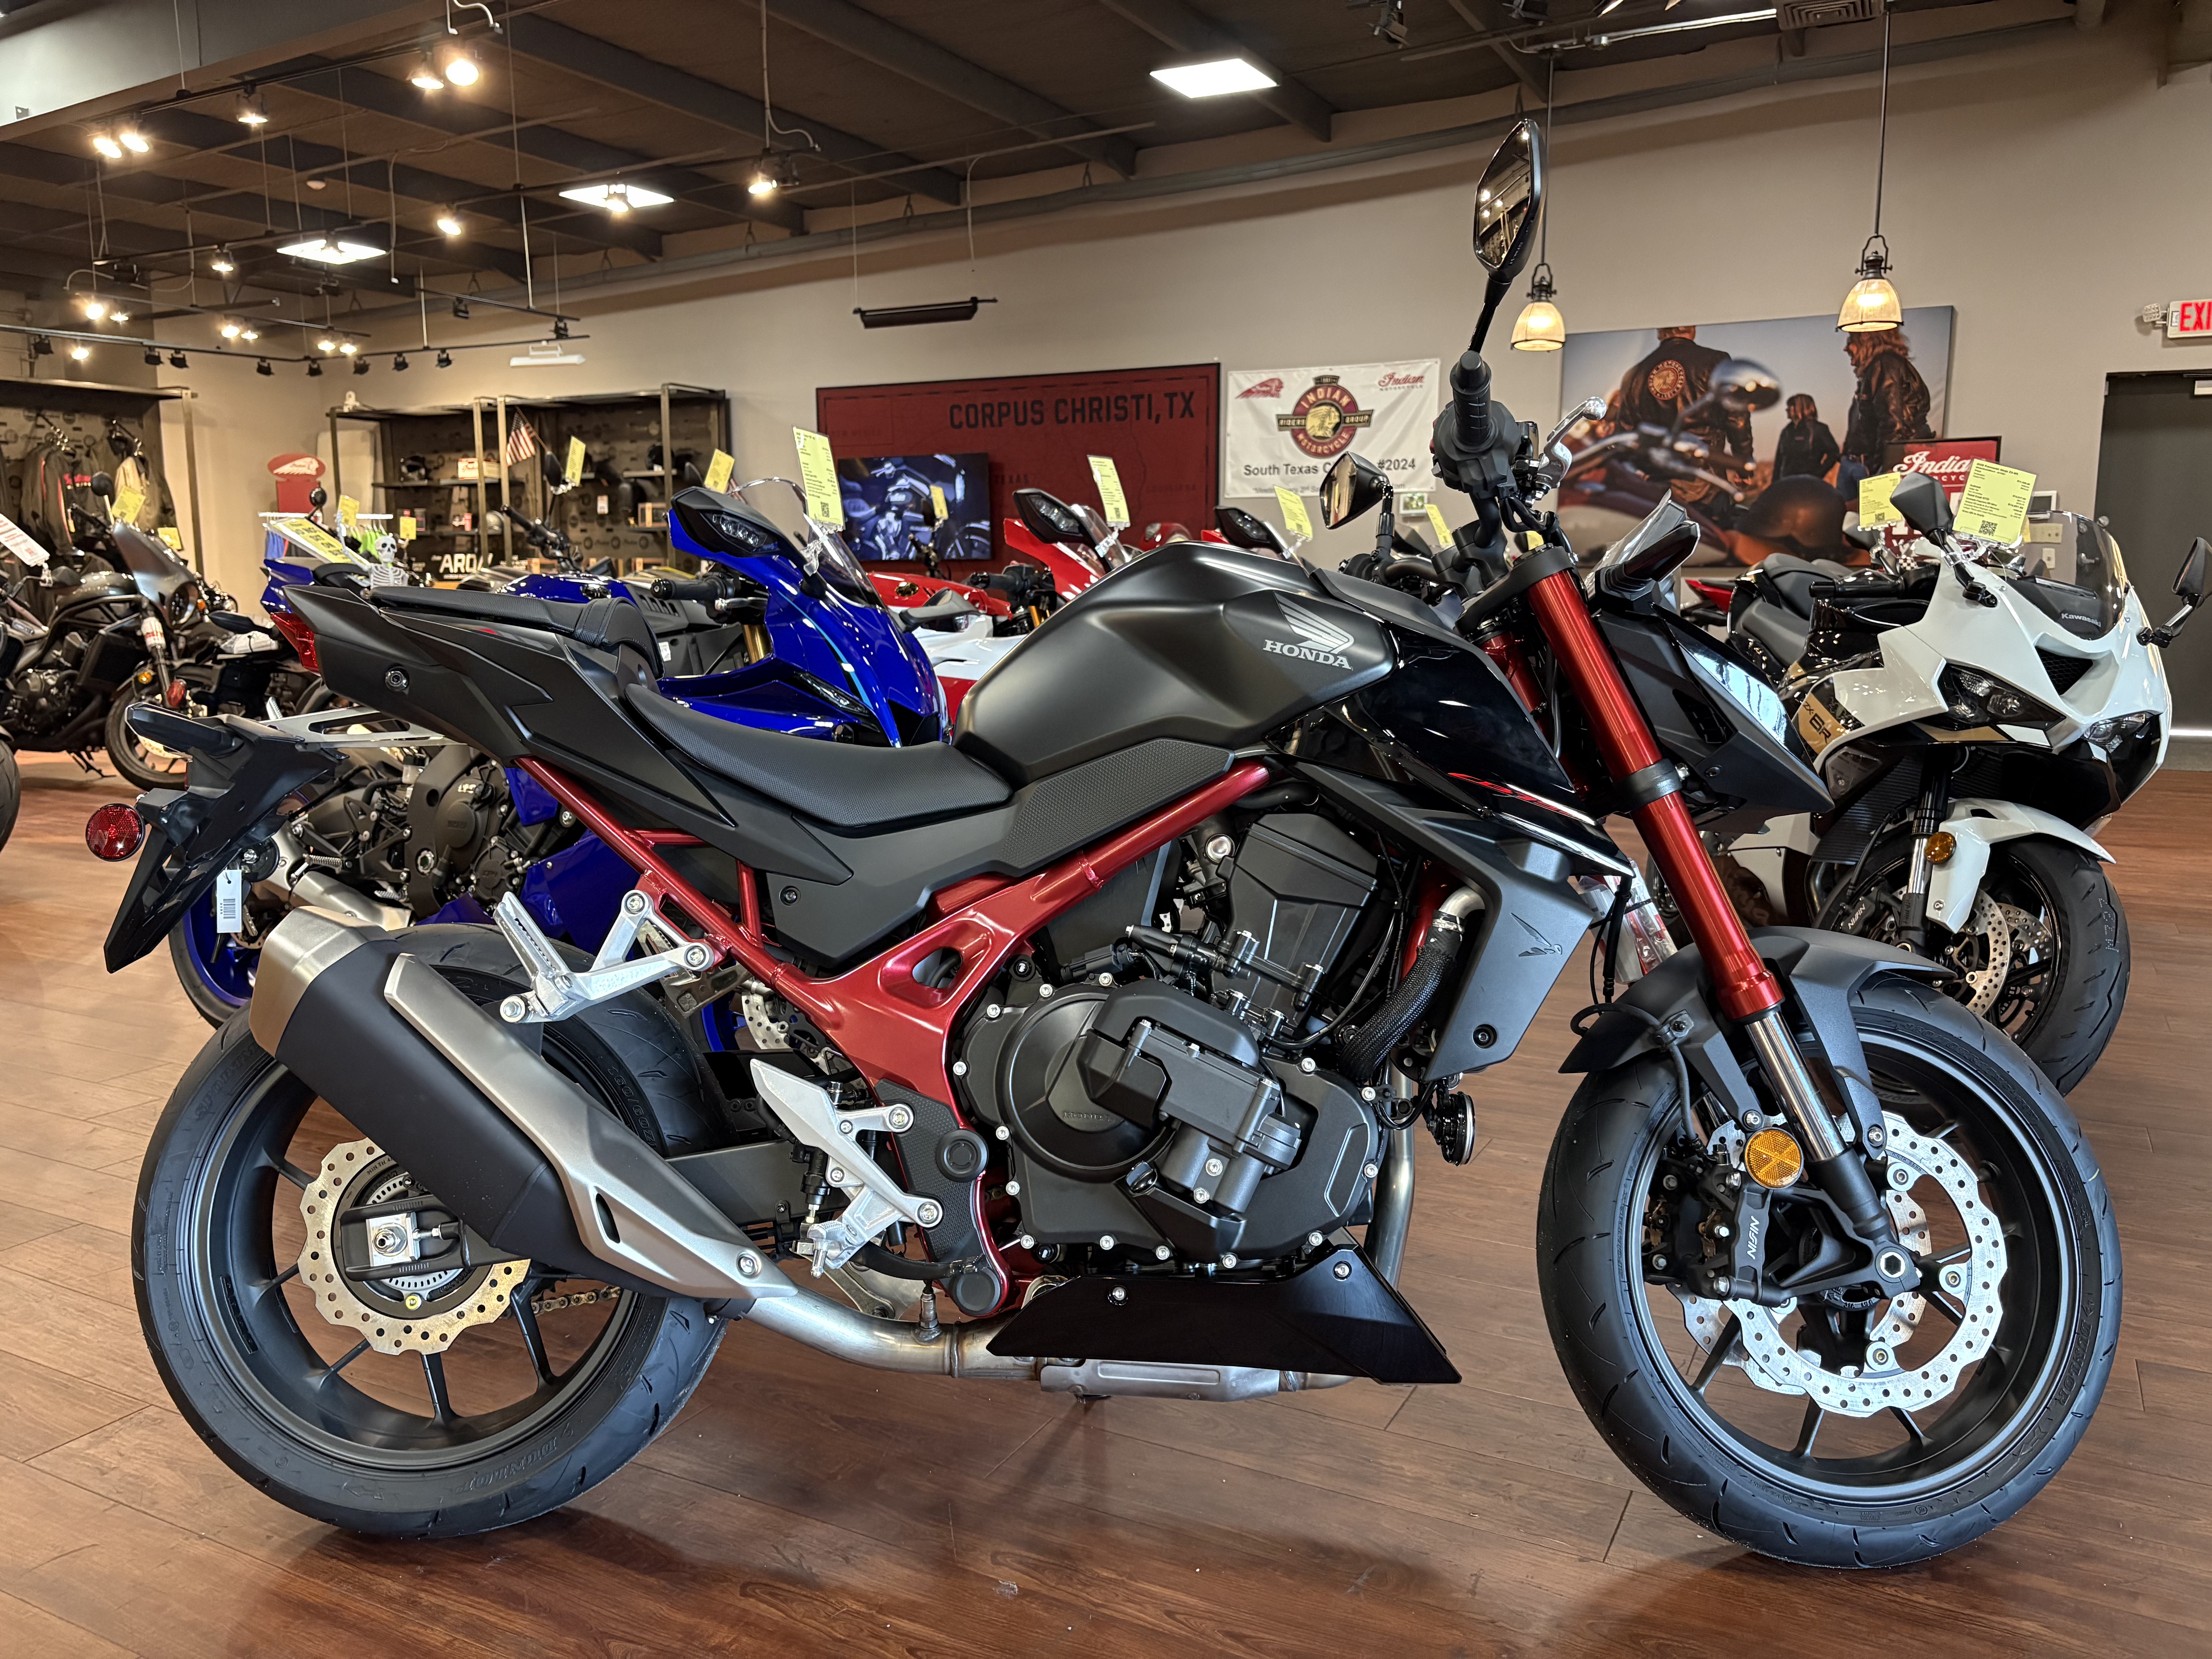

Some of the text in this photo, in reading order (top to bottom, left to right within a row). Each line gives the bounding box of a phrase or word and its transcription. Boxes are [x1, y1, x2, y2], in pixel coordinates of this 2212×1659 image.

[2179, 302, 2212, 332] EXI
[1378, 372, 1425, 387] Indian
[1300, 387, 1352, 409] INDIAN
[950, 400, 1044, 429] CORPUS
[1344, 414, 1370, 424] GROUP
[1297, 432, 1350, 454] MOTORCYCLE
[1244, 464, 1279, 476] South
[1284, 464, 1319, 475] Texas
[1377, 458, 1416, 471] #2024
[1893, 451, 1973, 475] India
[2061, 613, 2101, 627] Kawasaki
[1263, 639, 1352, 670] HONDA
[607, 1066, 656, 1147] 160/60Z
[2058, 1321, 2093, 1406] DUNLOP
[455, 1436, 557, 1494] DUNLOP
